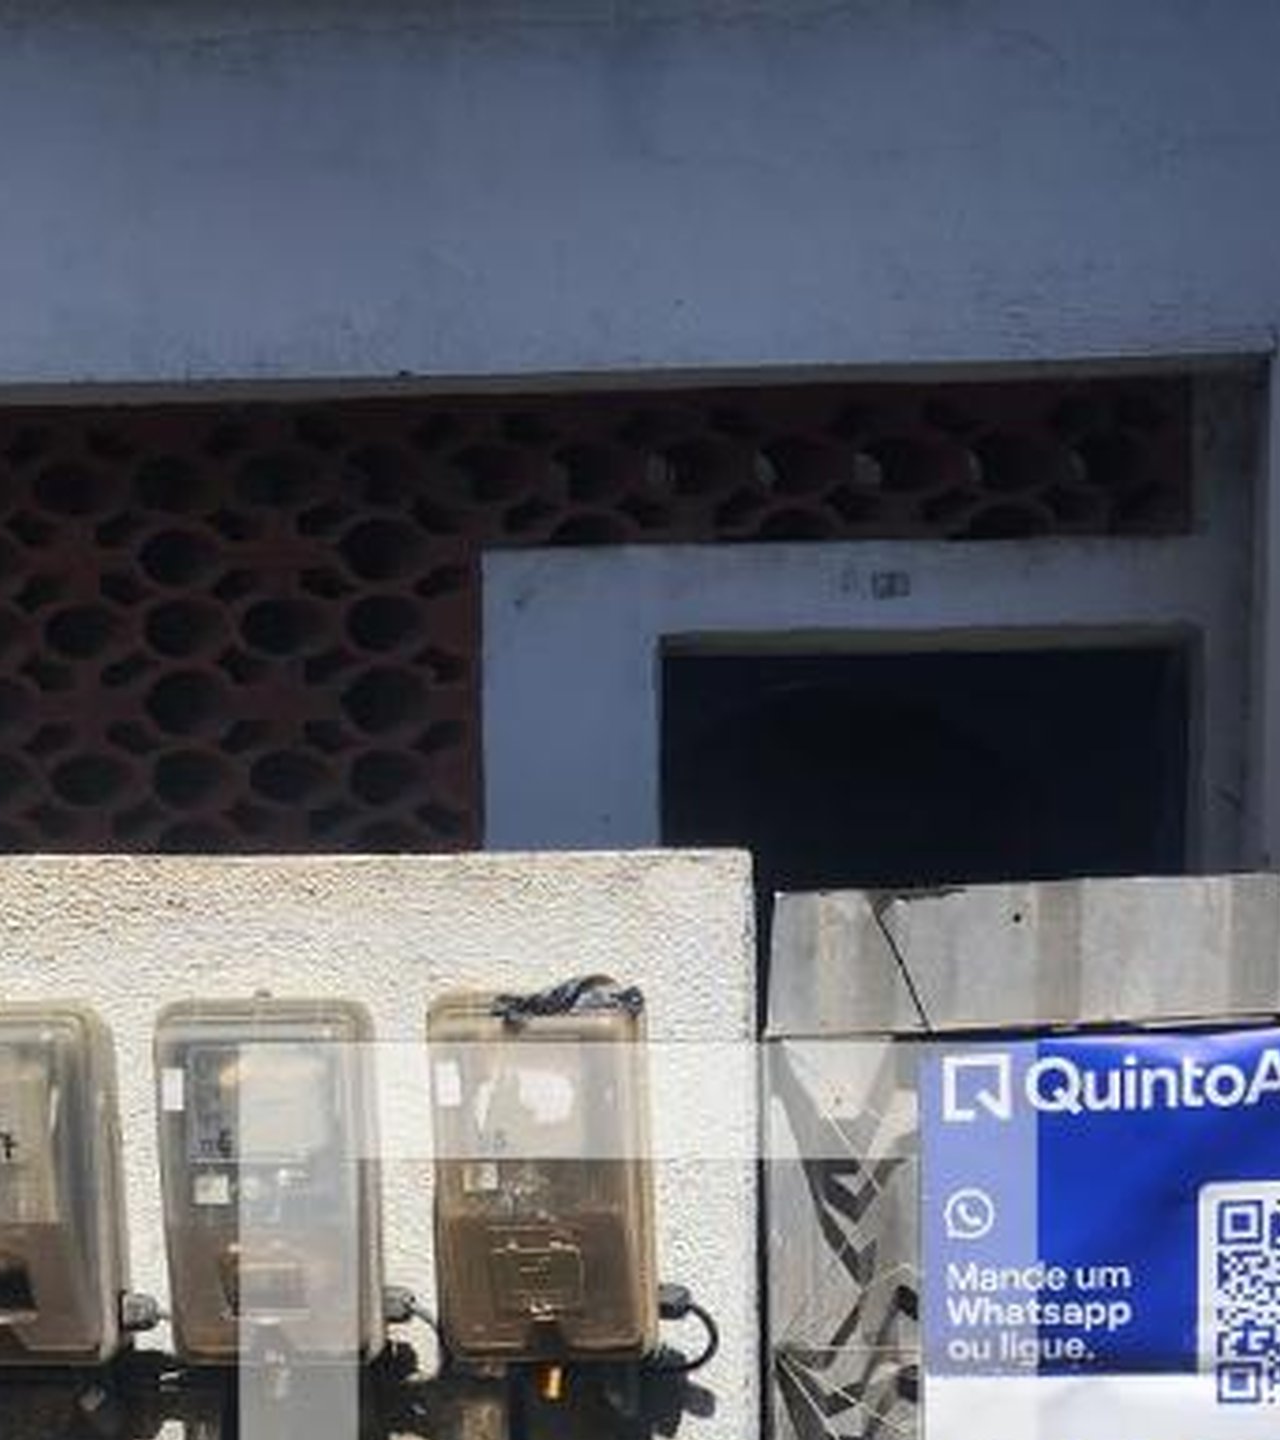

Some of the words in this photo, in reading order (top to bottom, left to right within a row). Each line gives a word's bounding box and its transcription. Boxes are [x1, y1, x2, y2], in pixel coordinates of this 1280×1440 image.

[946, 1262, 1068, 1292] Mande
[1074, 1265, 1132, 1289] um
[946, 1296, 1132, 1332] Whatsapp
[947, 1337, 991, 1361] ou
[1000, 1332, 1096, 1367] ligue.
